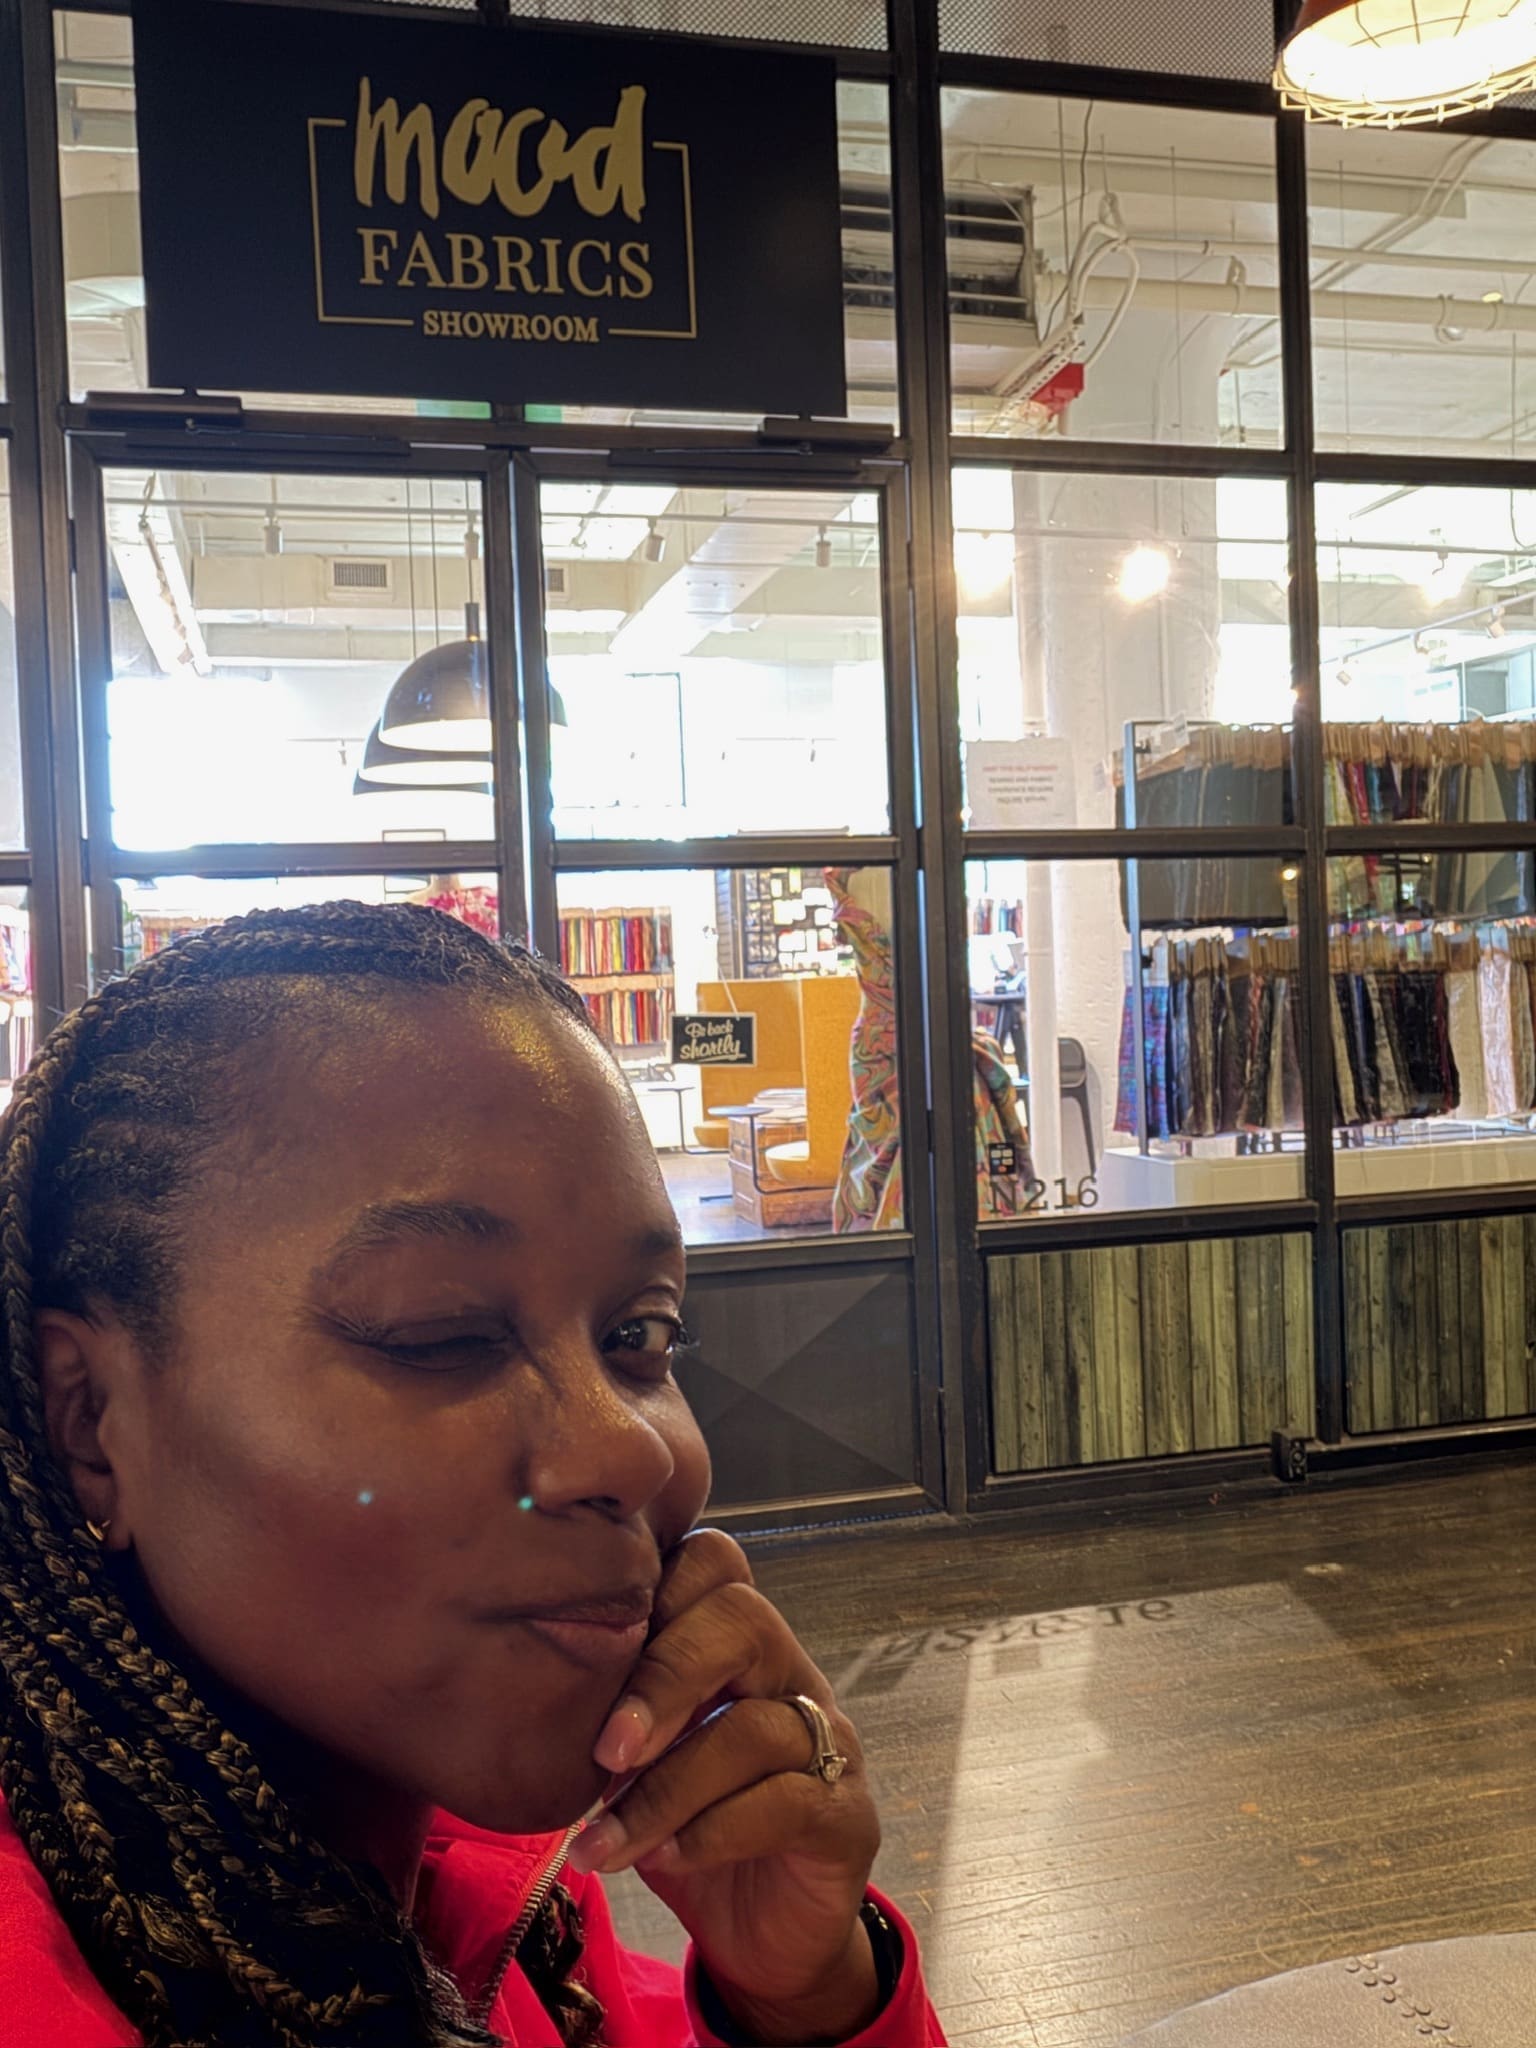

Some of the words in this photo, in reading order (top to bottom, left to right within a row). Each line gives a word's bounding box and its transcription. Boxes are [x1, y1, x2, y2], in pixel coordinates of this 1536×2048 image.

[357, 227, 654, 299] FABRICS
[423, 310, 599, 343] SHOWROOM
[707, 1019, 734, 1037] back
[680, 1034, 746, 1061] shortly
[989, 1175, 1099, 1214] N216
